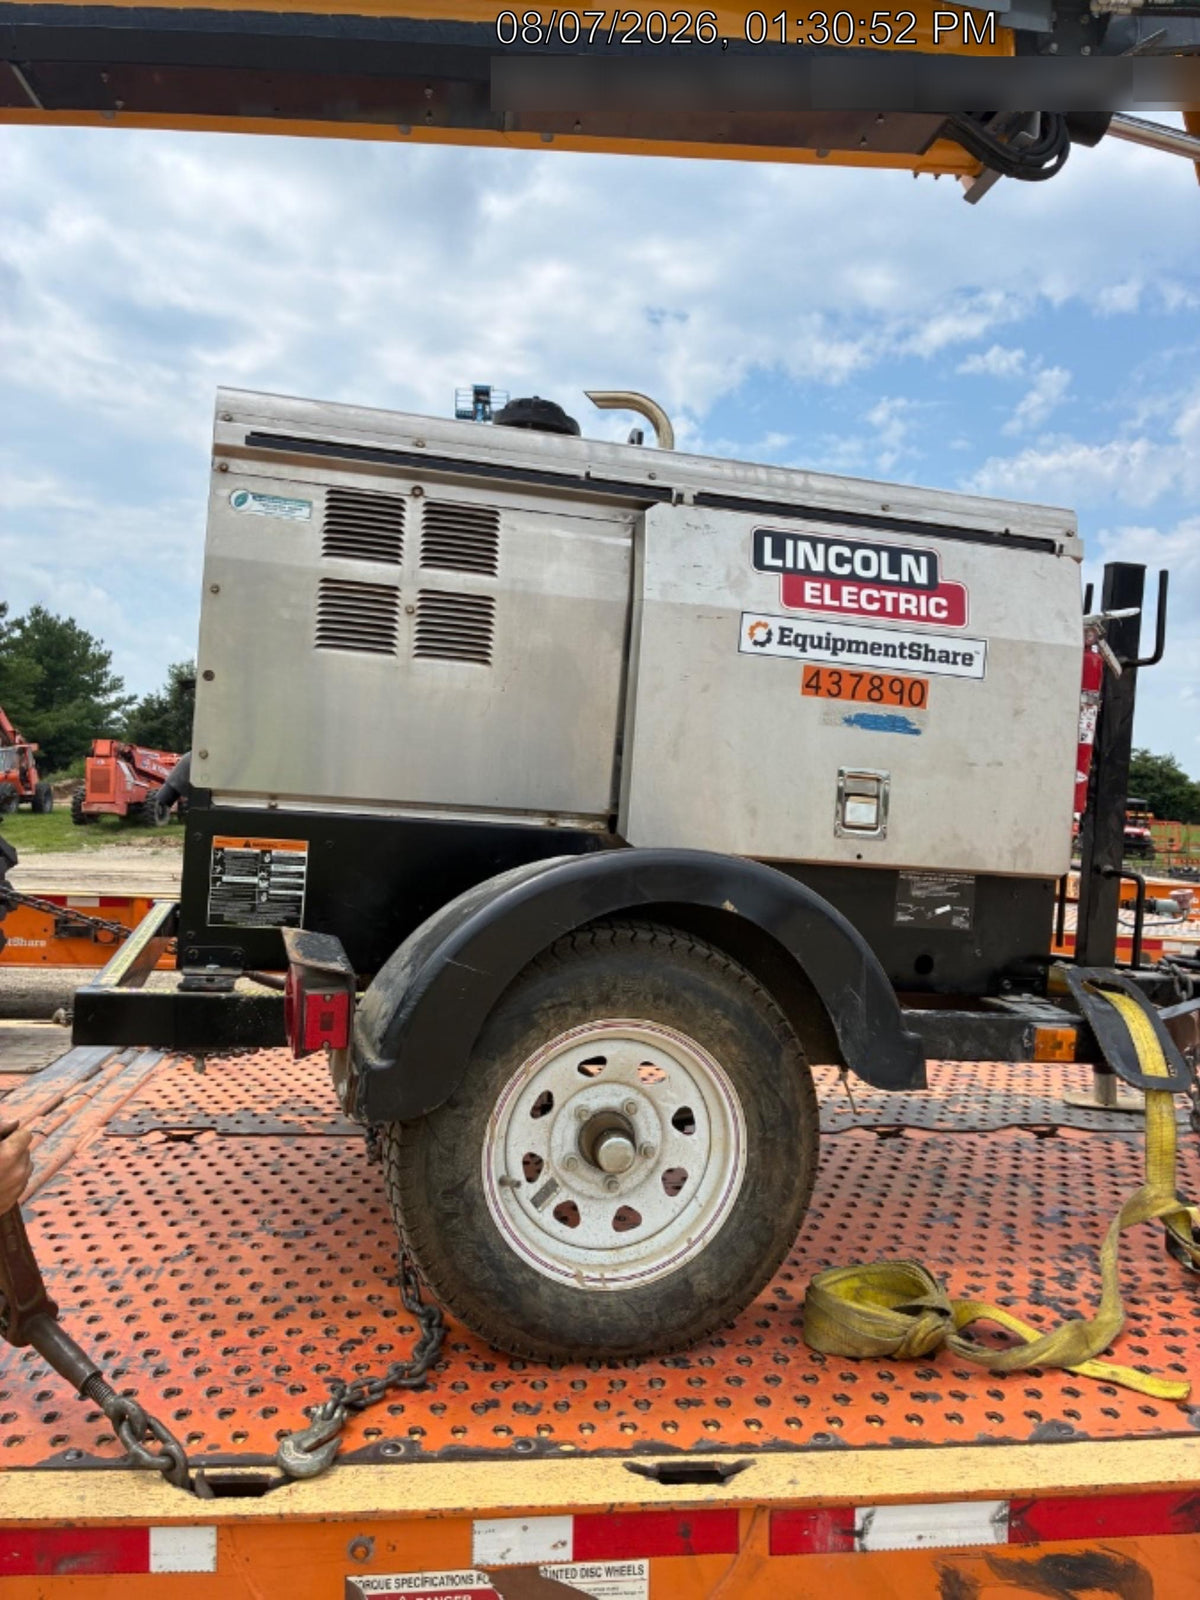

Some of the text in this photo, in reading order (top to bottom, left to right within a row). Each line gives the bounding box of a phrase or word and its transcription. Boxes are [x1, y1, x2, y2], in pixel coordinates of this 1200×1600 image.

[763, 535, 929, 585] LINCOLN
[803, 580, 949, 619] ELECTRIC
[776, 625, 975, 668] EquipmentShare
[804, 669, 926, 707] 437890
[394, 1573, 474, 1588] SPECIFICATIONS
[580, 1566, 602, 1579] DISC
[605, 1564, 645, 1577] WHEELS
